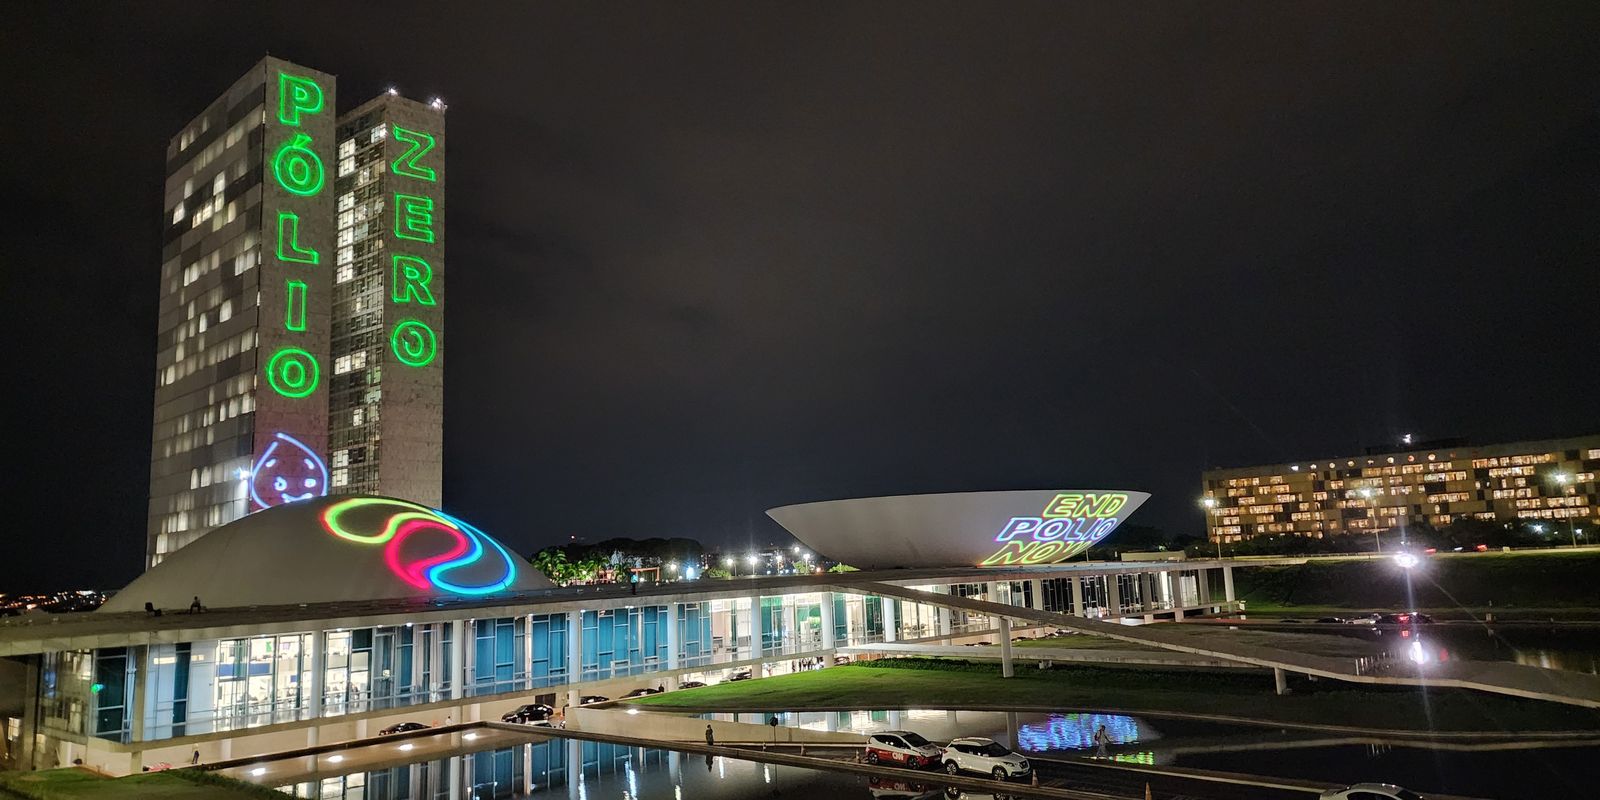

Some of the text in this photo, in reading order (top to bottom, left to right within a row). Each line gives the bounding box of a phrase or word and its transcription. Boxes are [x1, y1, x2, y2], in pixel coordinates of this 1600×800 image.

[268, 72, 325, 398] PÓLIO
[391, 125, 436, 367] ZERO
[1043, 494, 1128, 518] END
[994, 517, 1118, 541] POLIO
[980, 540, 1092, 565] NOW
